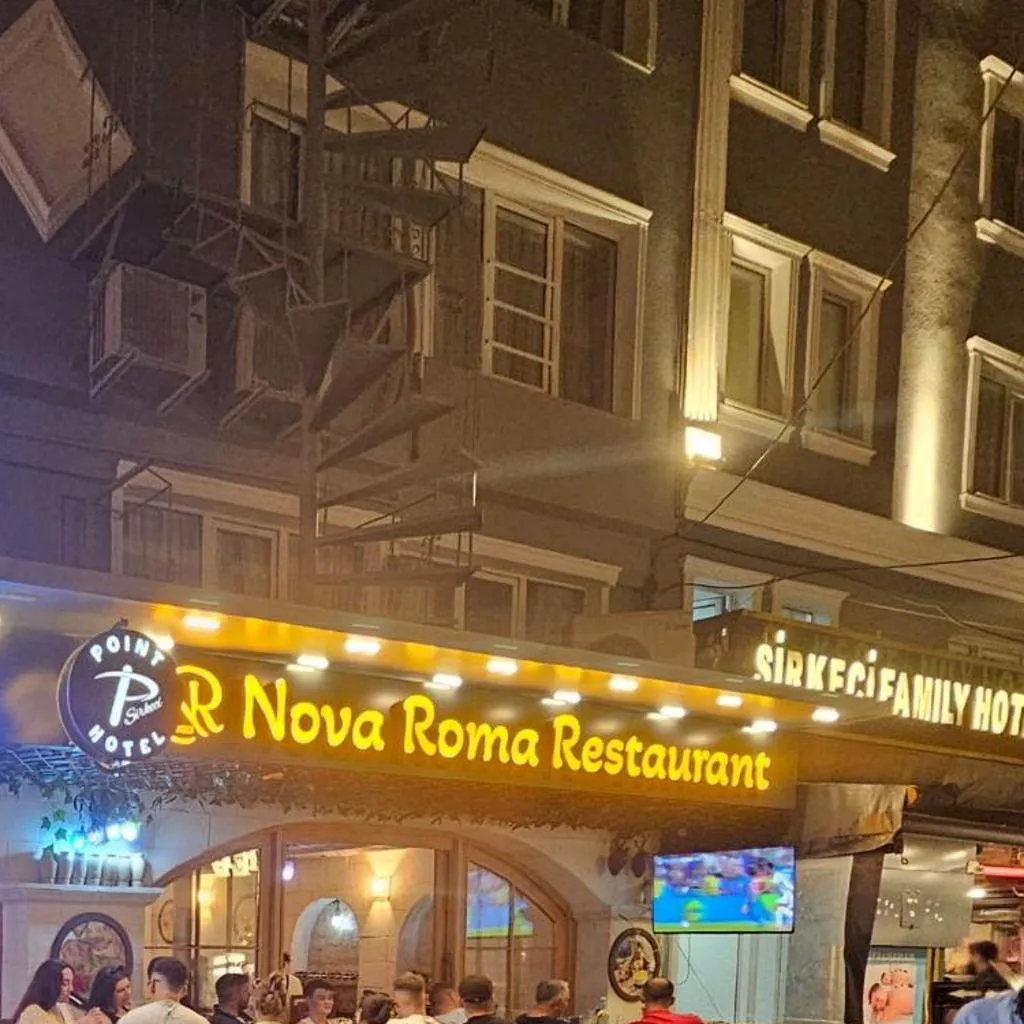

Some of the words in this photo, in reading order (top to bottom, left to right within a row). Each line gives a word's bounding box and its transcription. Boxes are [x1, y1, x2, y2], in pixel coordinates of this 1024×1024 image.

[90, 635, 166, 667] POINT
[879, 667, 971, 726] FAMILY
[970, 686, 1024, 738] HOT
[88, 724, 166, 757] HOTEL
[242, 673, 385, 751] Nova
[401, 694, 540, 769] Roma
[551, 715, 772, 791] Restaurant
